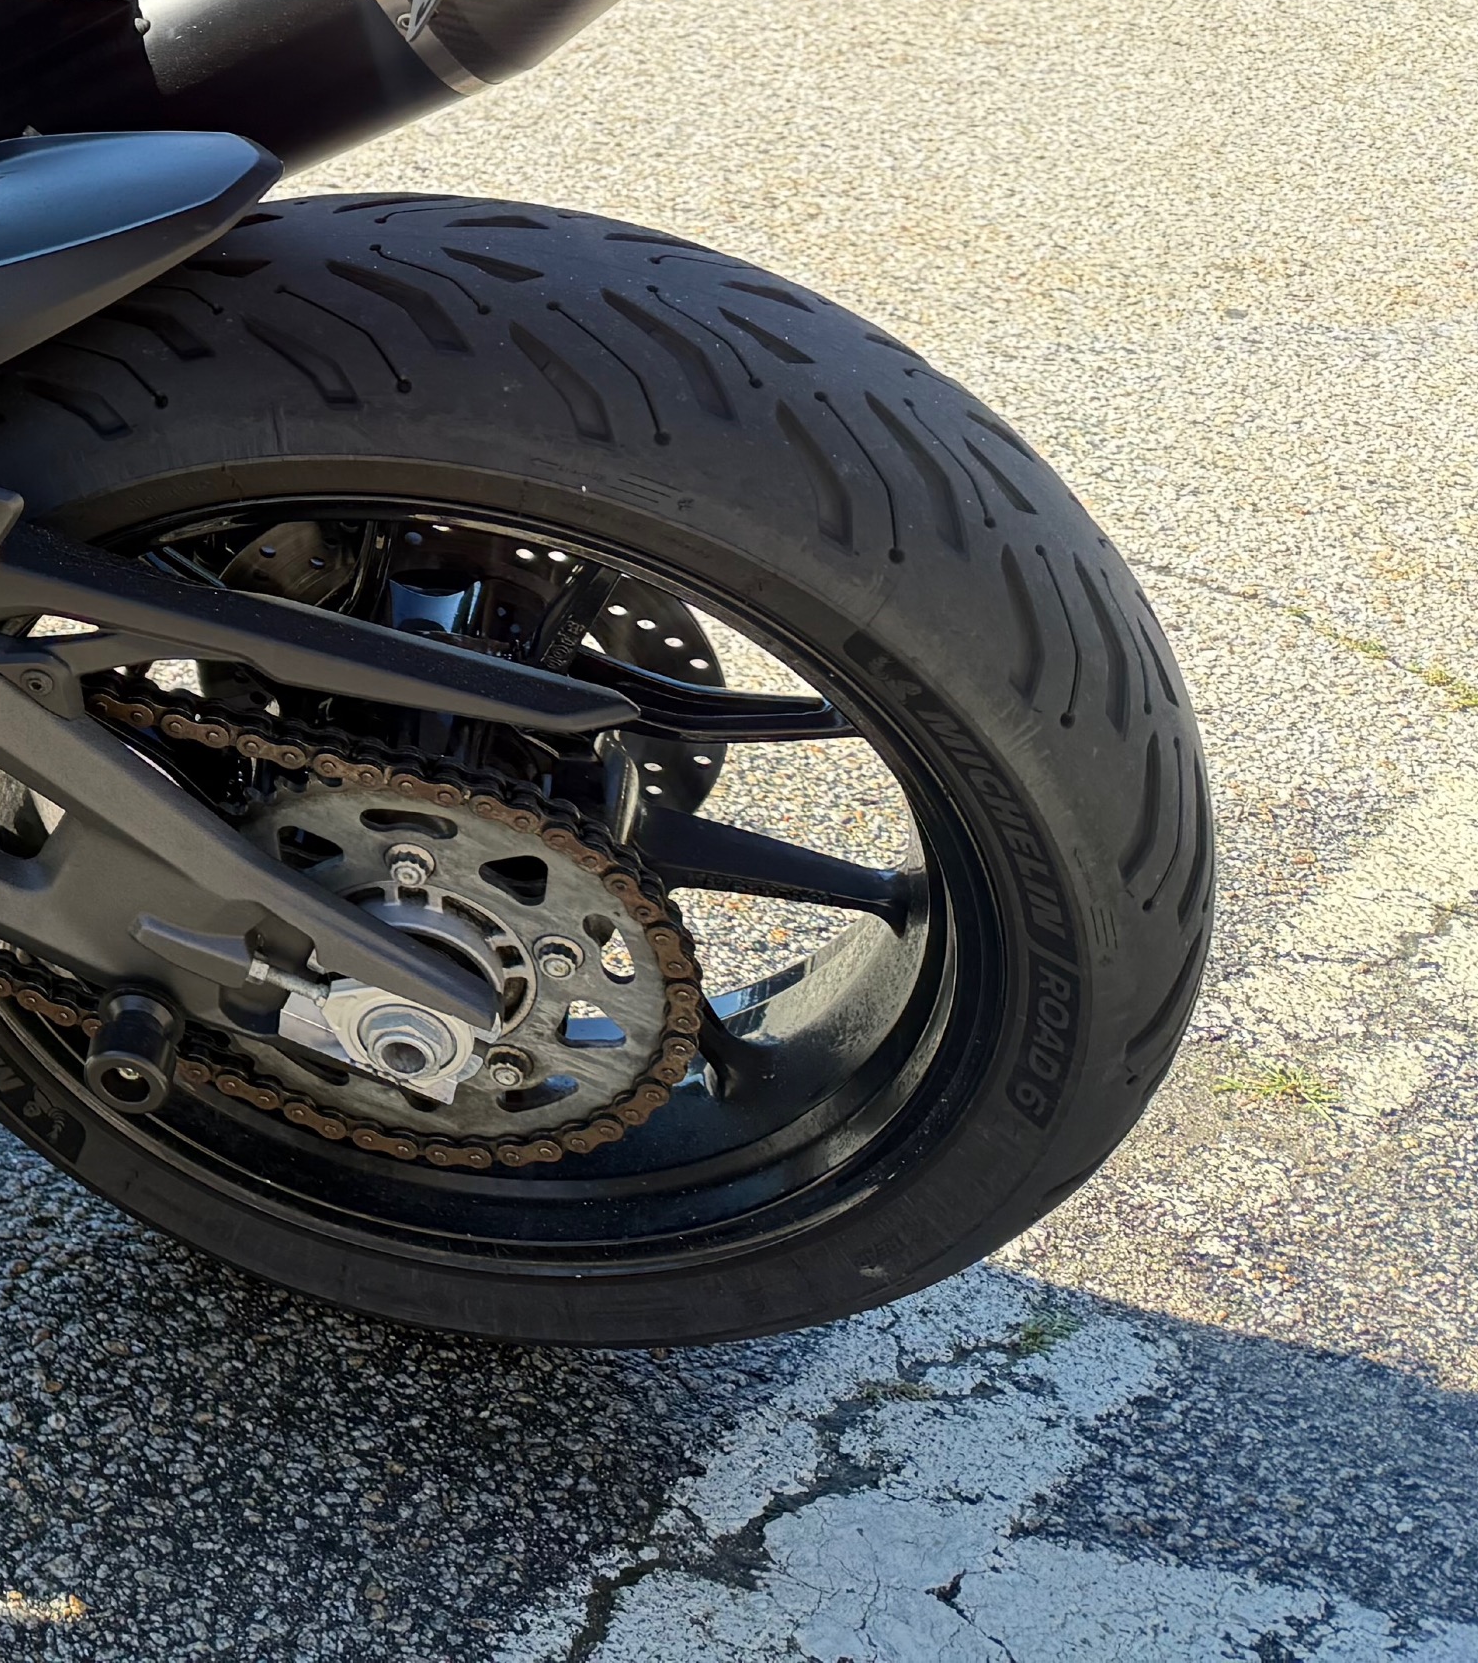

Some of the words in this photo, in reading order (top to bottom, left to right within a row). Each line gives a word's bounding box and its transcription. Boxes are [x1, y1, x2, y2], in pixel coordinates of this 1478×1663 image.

[915, 710, 1067, 938] MICHELIN
[1029, 965, 1071, 1081] ROAD
[1015, 1081, 1046, 1117] 6
